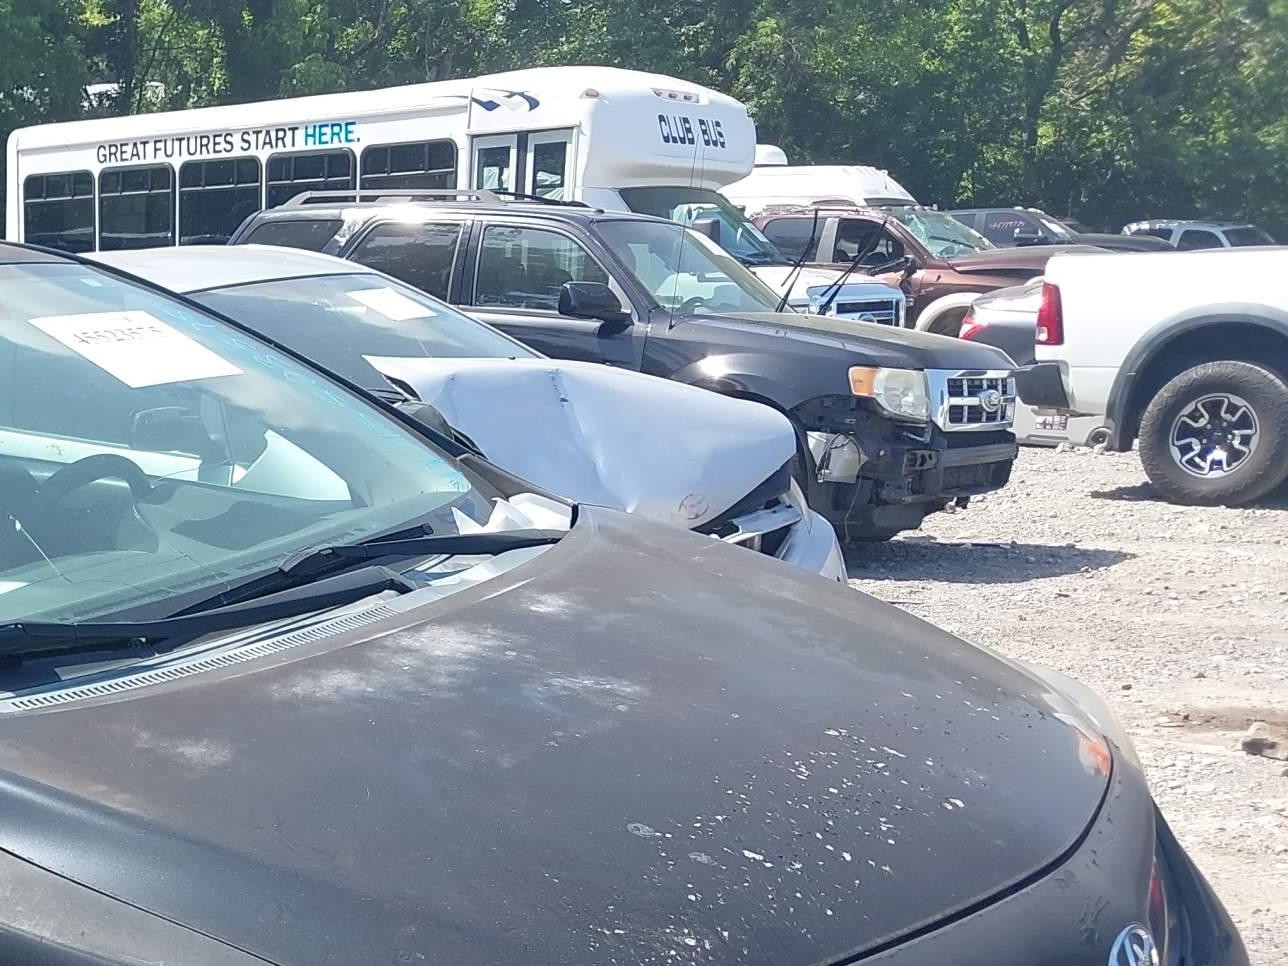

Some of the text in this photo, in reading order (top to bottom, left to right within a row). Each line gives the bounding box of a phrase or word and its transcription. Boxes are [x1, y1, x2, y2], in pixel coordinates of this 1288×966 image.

[96, 121, 361, 164] GREAT FUTURES START HERE.
[658, 113, 726, 149] CLUB BUS
